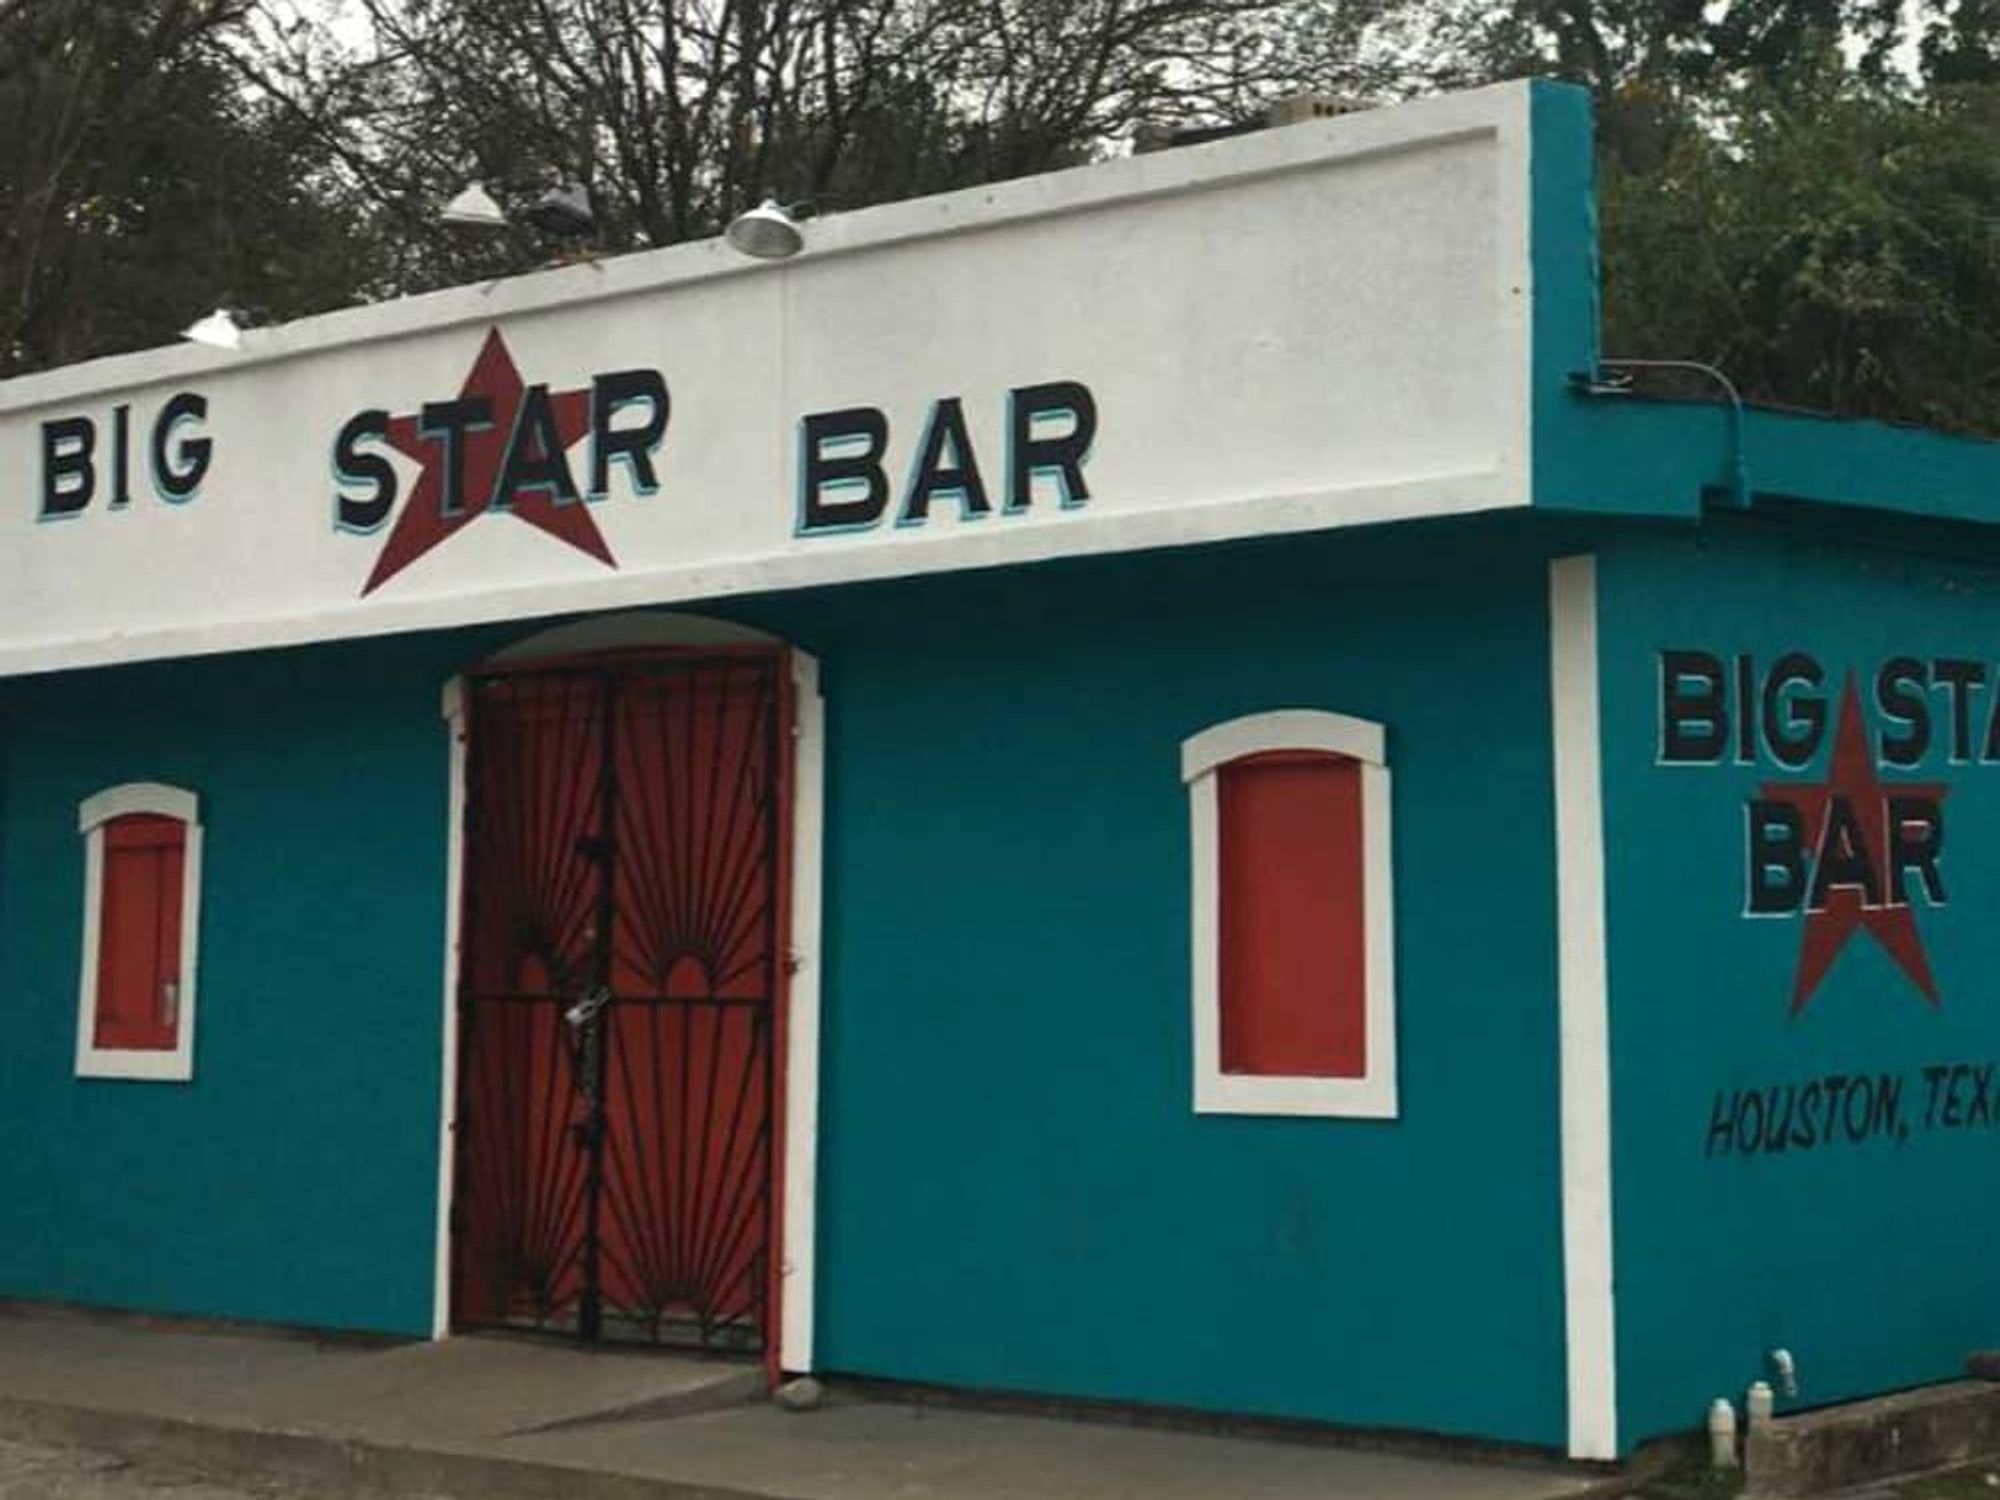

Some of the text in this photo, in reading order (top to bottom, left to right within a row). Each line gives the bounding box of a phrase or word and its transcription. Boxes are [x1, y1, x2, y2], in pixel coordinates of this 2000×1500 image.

[37, 367, 1098, 538] BIG STAR BAR
[1655, 650, 1828, 771] BIG
[1742, 796, 1947, 919] BAR
[1704, 1063, 2000, 1157] HOUSTON, TEX
